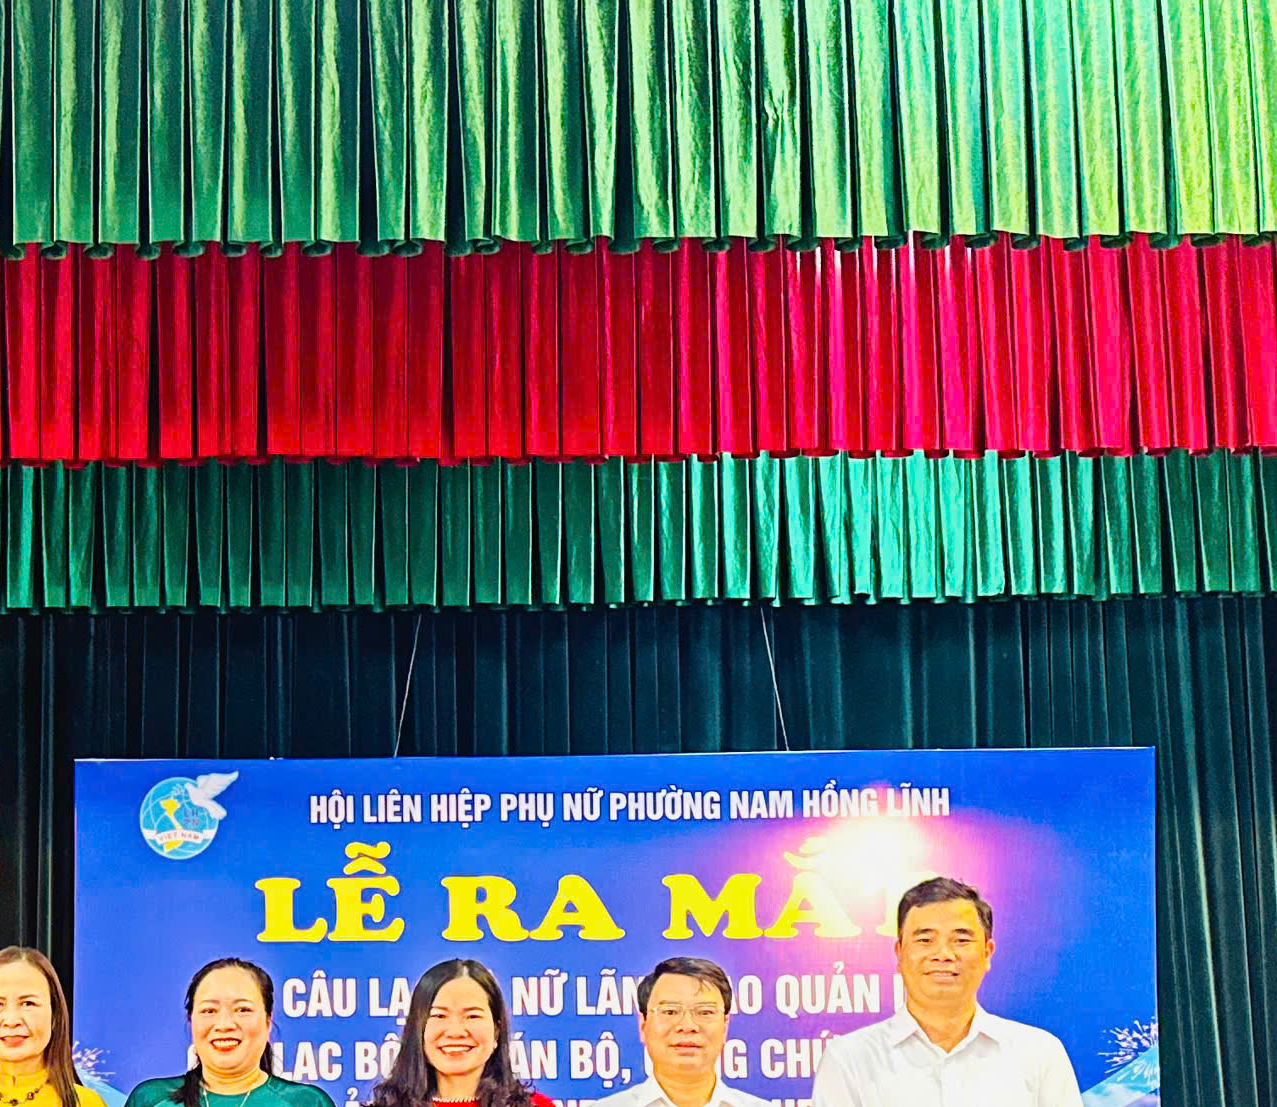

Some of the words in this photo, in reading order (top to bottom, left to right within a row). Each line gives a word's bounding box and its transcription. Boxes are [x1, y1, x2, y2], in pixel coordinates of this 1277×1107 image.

[310, 789, 354, 829] HỘI
[363, 789, 422, 823] LIÊN
[430, 788, 491, 828] HIỆP
[500, 792, 554, 828] PHỤ
[562, 787, 604, 822] NỮ
[609, 784, 721, 821] PHƯỜNG
[729, 790, 794, 819] NAM
[802, 780, 877, 818] HỒNG
[886, 783, 950, 817] LĨNH
[255, 841, 405, 943] LỄ
[441, 874, 626, 942] RA
[282, 969, 356, 1018] CÂU
[368, 977, 413, 1026] LẠ
[511, 968, 569, 1016] NỮ
[576, 968, 645, 1016] LÃN
[775, 961, 880, 1019] QUẢN
[508, 1031, 558, 1080] ÁN
[569, 1031, 631, 1088] BỘ,
